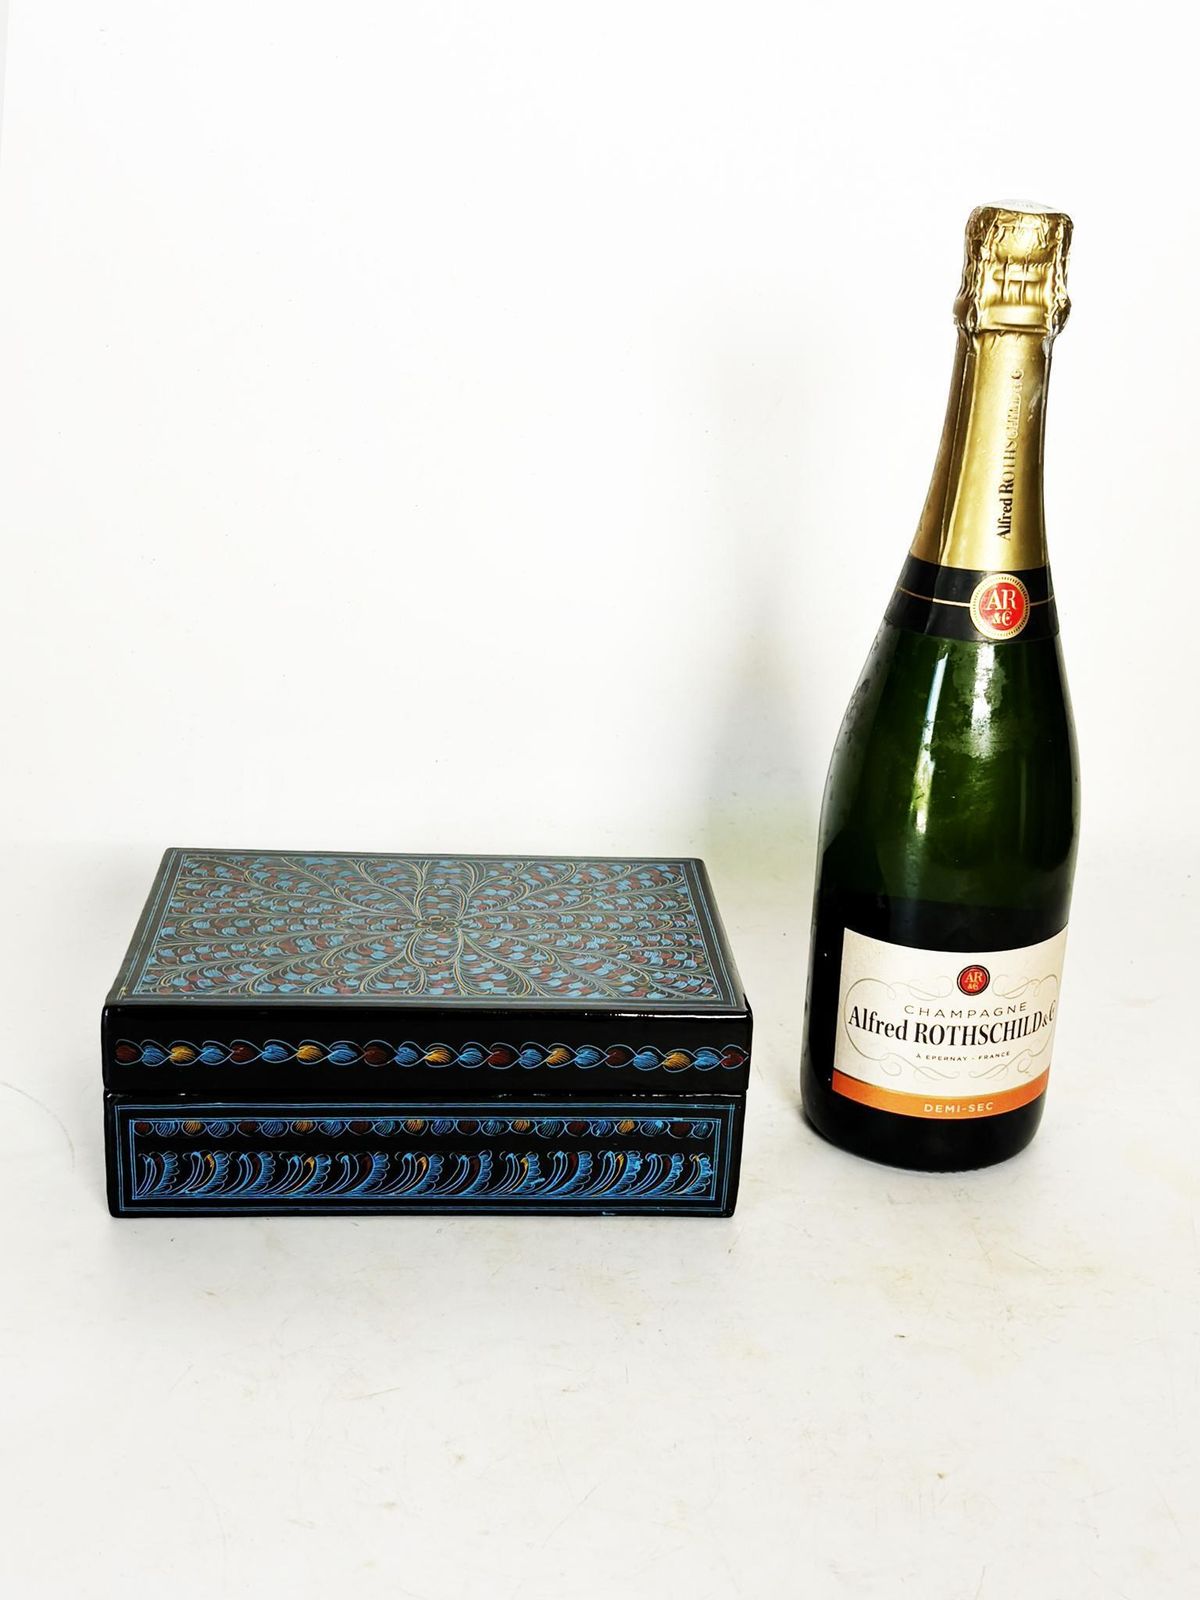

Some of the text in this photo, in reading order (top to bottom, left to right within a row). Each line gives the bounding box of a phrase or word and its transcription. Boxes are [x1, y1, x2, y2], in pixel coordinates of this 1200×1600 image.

[995, 497, 1014, 541] Alfred
[985, 588, 1017, 610] AR
[965, 971, 984, 983] AR
[904, 1002, 1028, 1019] CHAMPAGNE
[848, 1005, 908, 1041] Alfred
[978, 1051, 1010, 1060] FRANCE
[923, 1101, 994, 1113] DEMI-SEC
